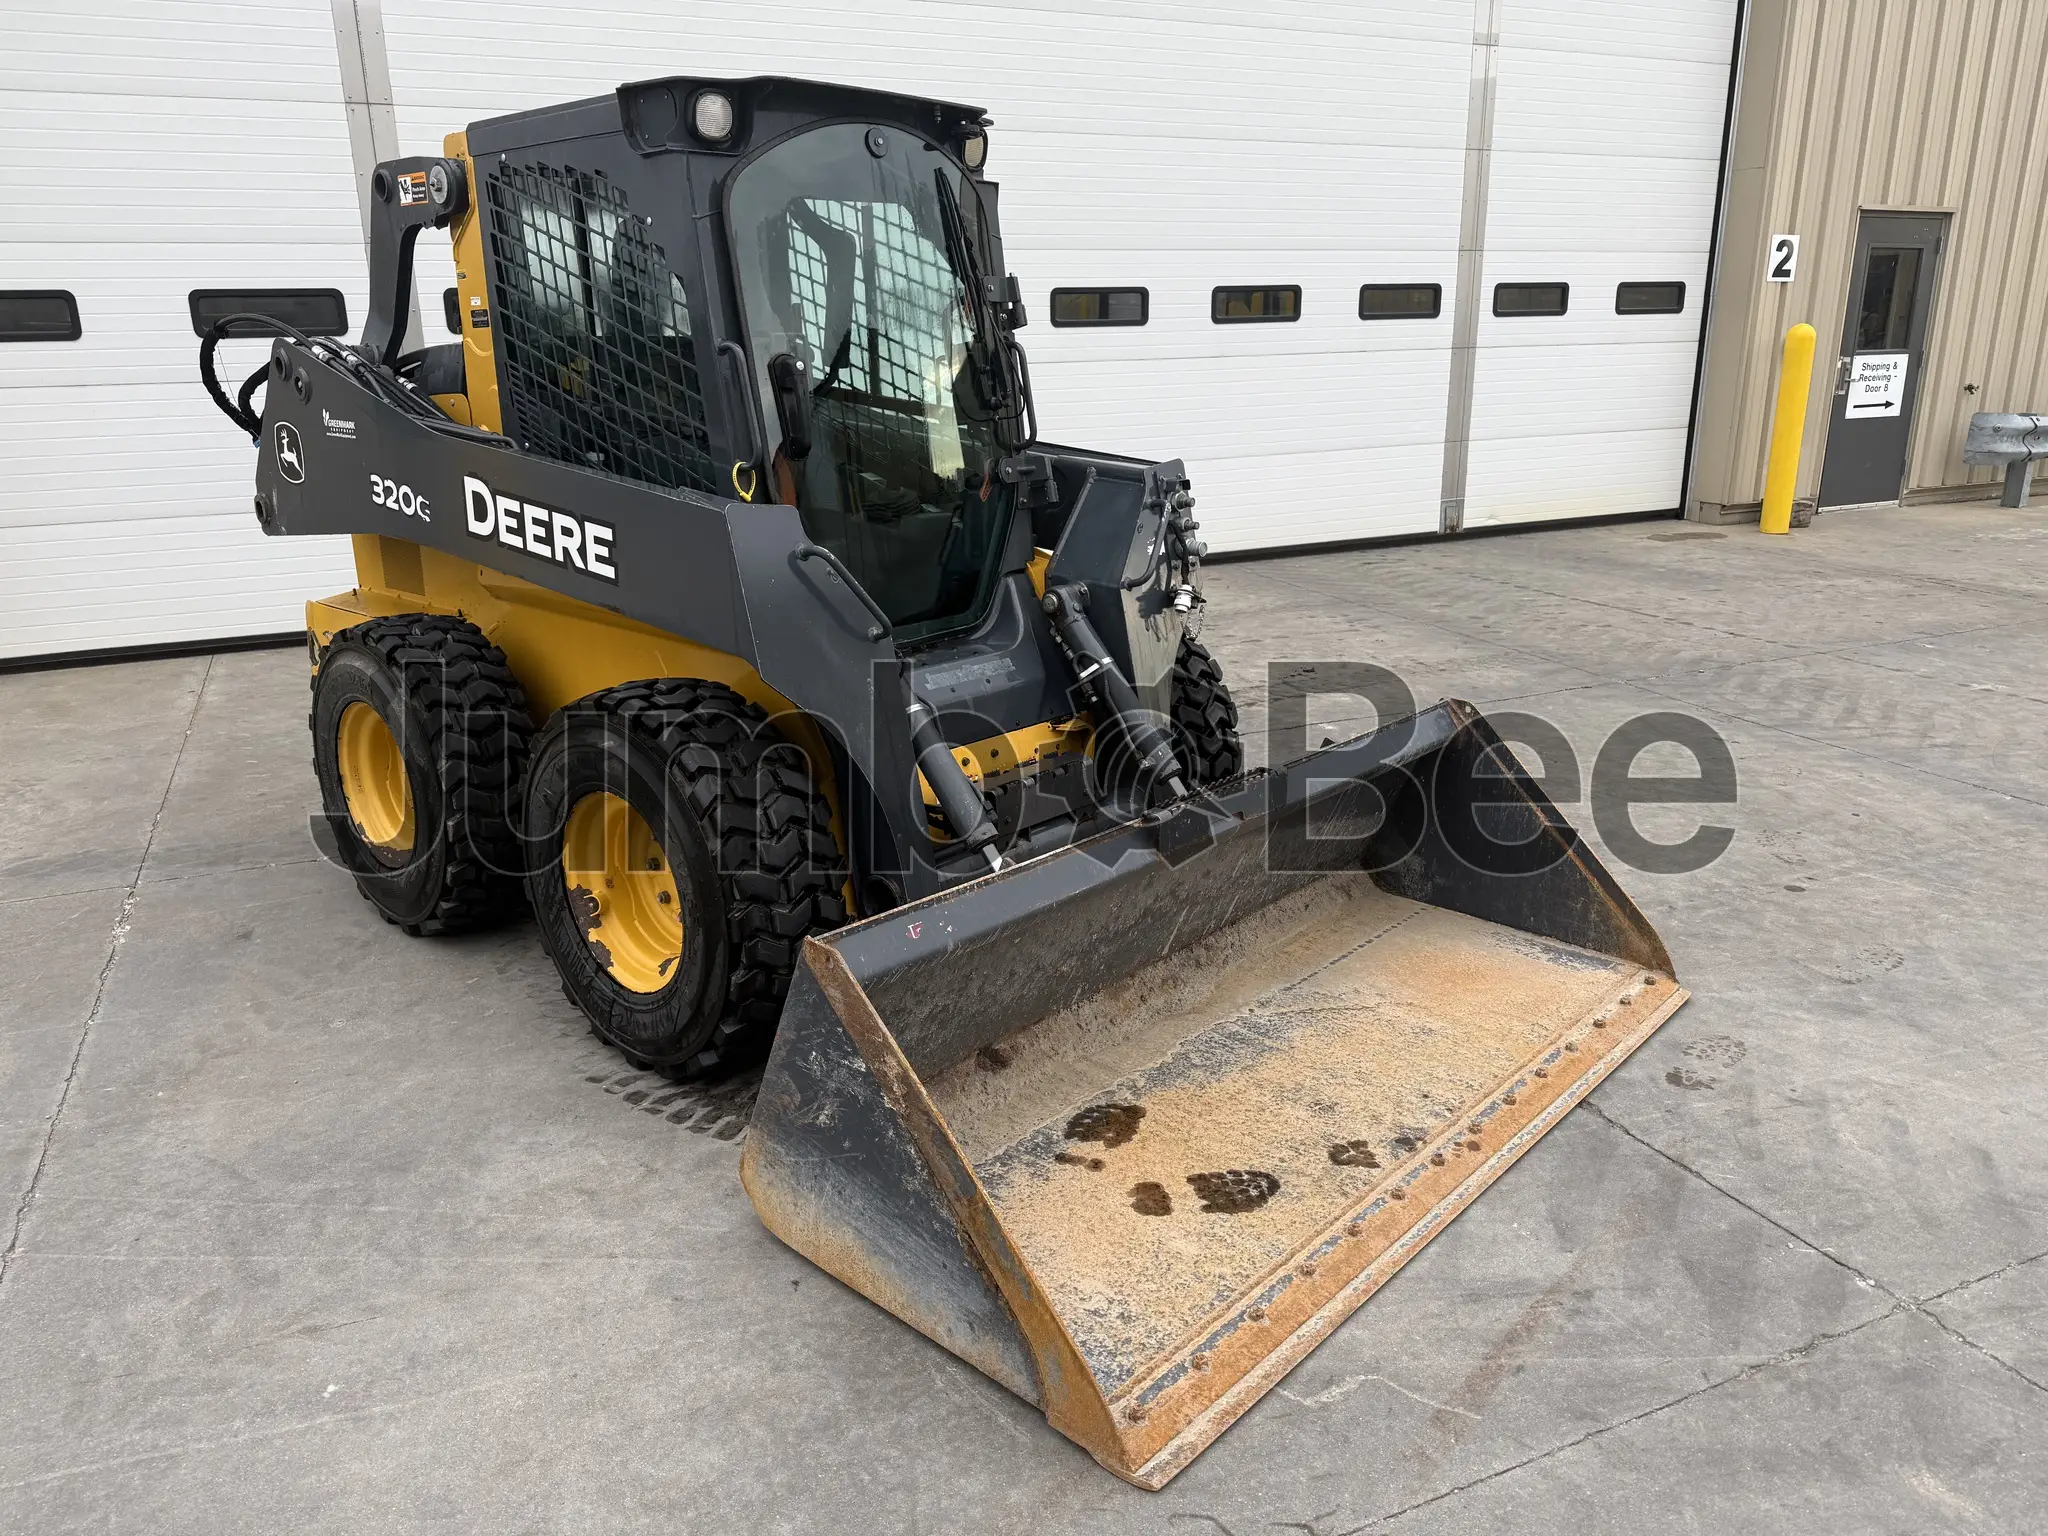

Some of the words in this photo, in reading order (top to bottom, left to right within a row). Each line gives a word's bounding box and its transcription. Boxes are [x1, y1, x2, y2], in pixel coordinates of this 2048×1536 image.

[1772, 239, 1794, 277] 2
[1861, 362, 1891, 372] Shipping
[1892, 361, 1898, 370] &
[1860, 373, 1892, 382] Receiving
[1865, 384, 1882, 393] Door
[463, 475, 616, 579] DEERE
